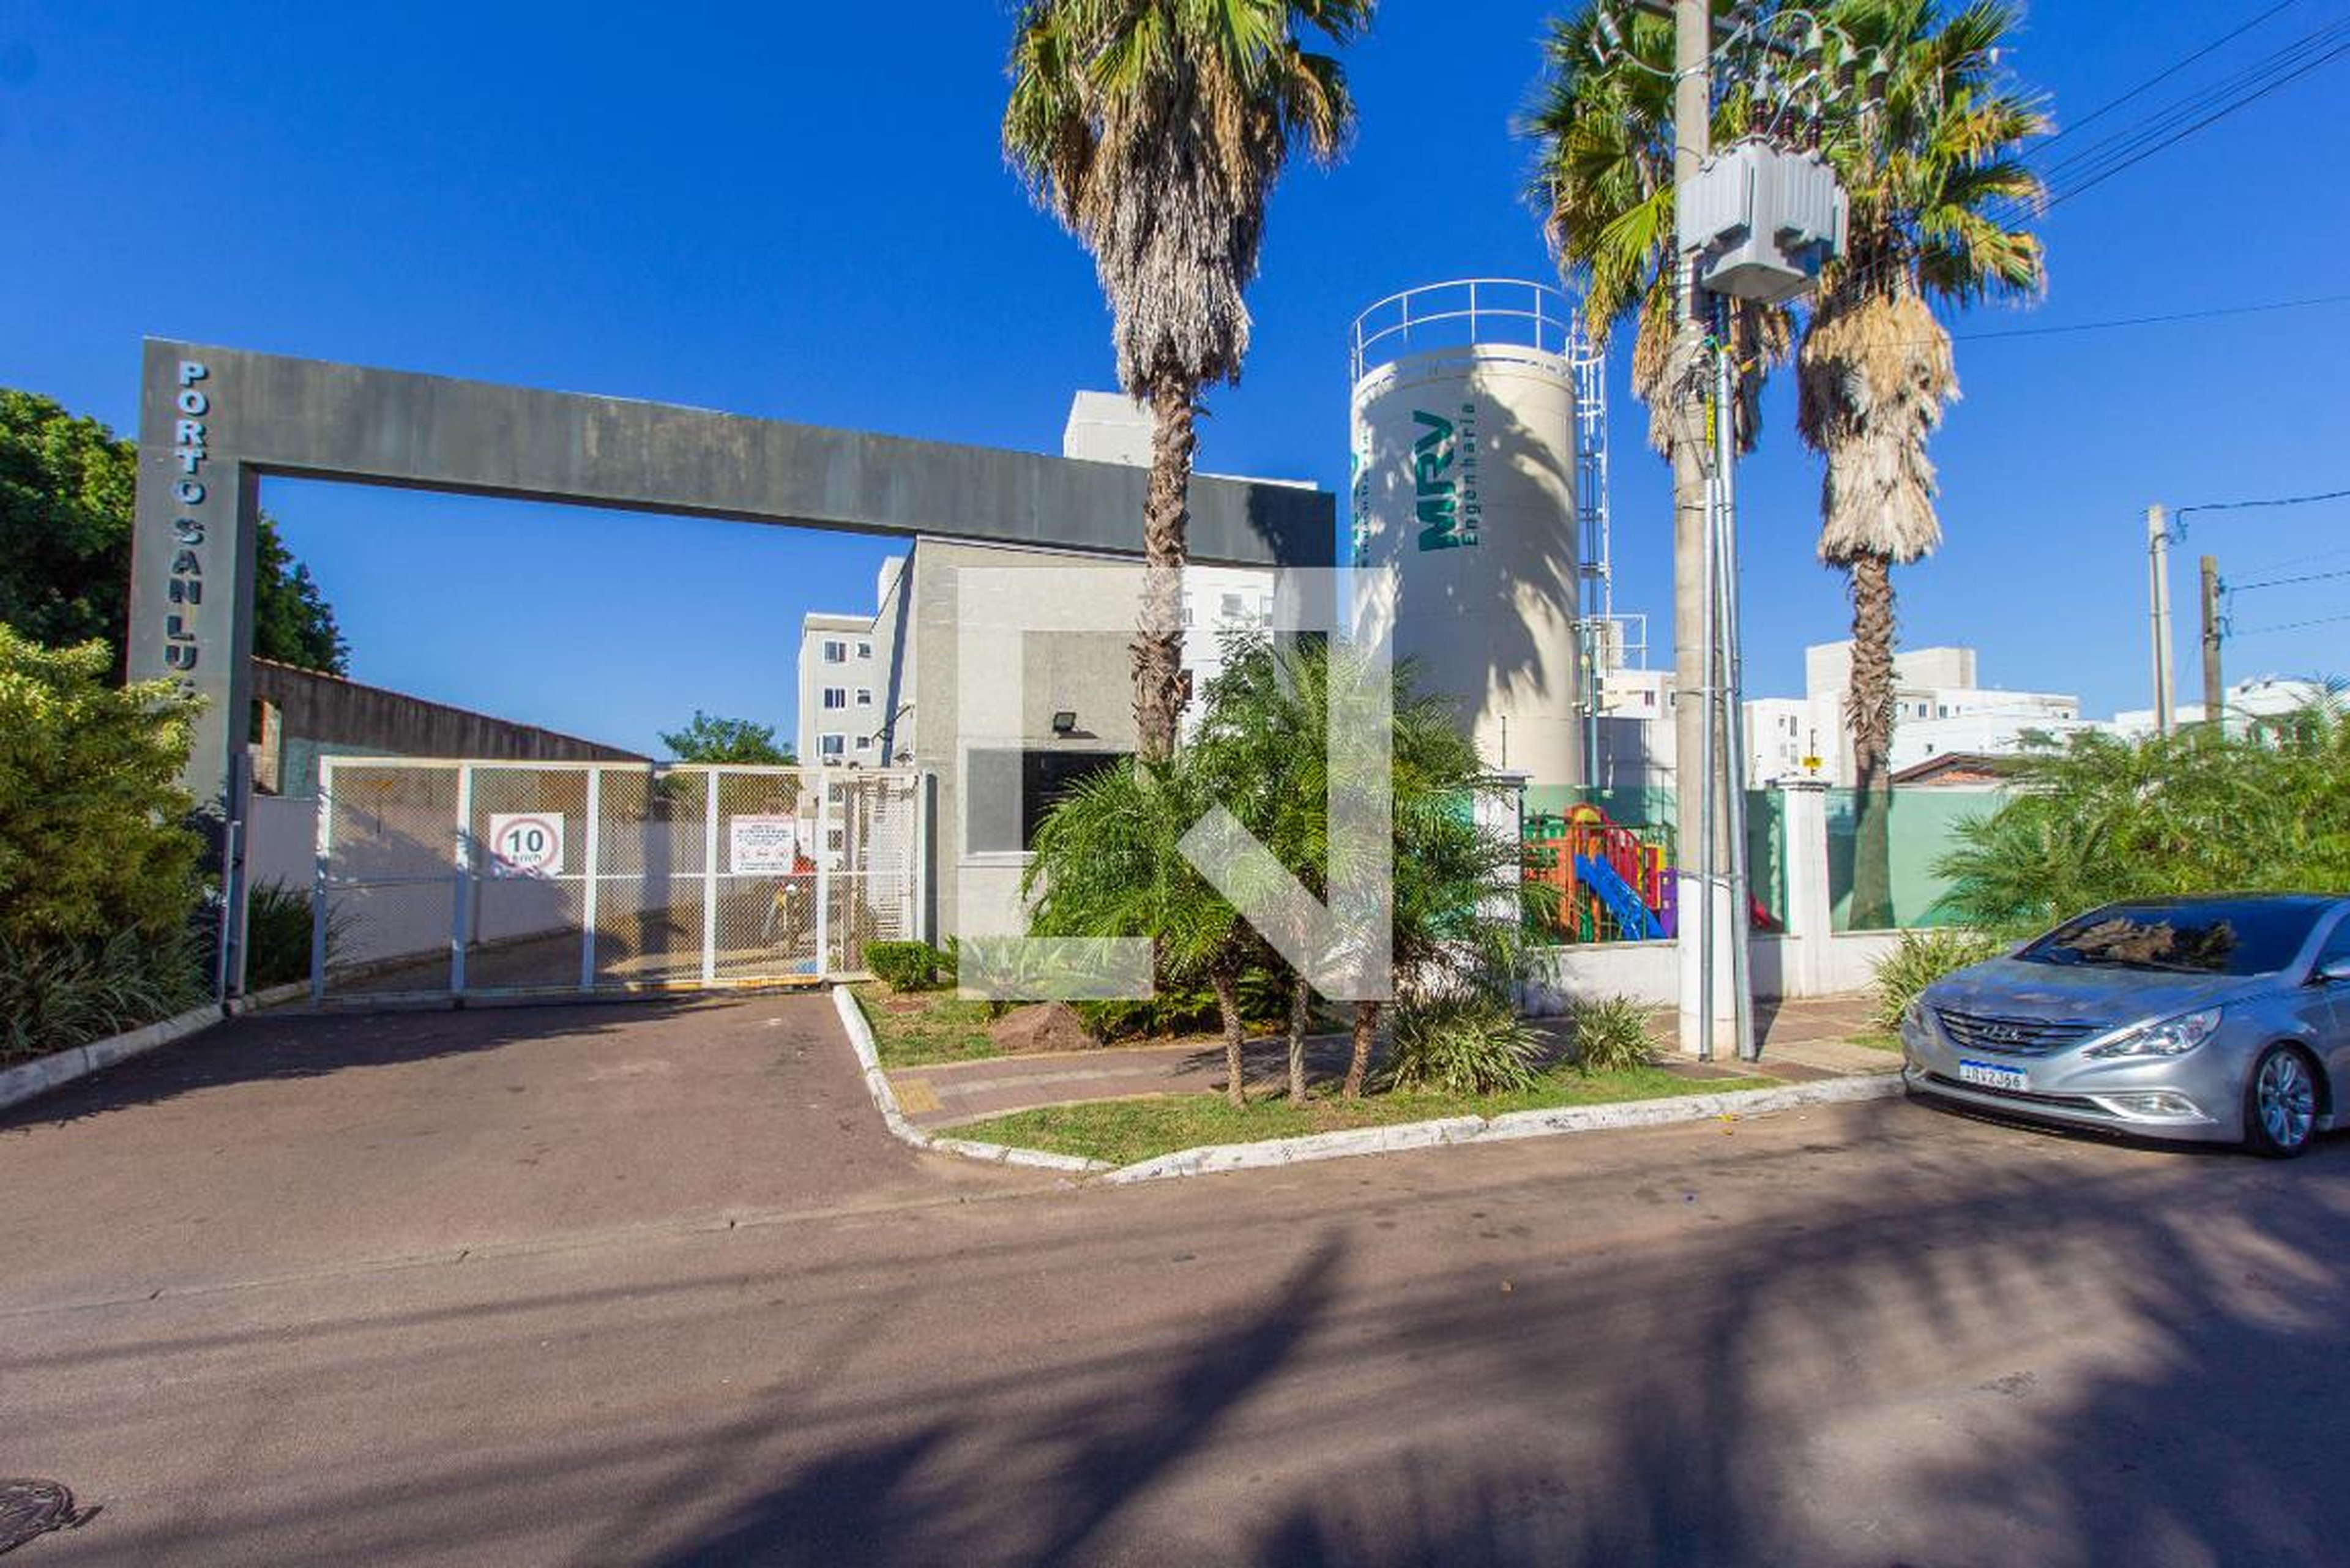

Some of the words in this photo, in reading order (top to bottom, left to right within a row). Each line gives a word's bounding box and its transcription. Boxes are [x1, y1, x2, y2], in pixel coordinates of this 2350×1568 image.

[176, 361, 209, 506] PORTO
[1412, 409, 1460, 551] MRV
[1460, 403, 1481, 547] Engenharia
[169, 517, 204, 605] SAN
[508, 829, 544, 853] 10
